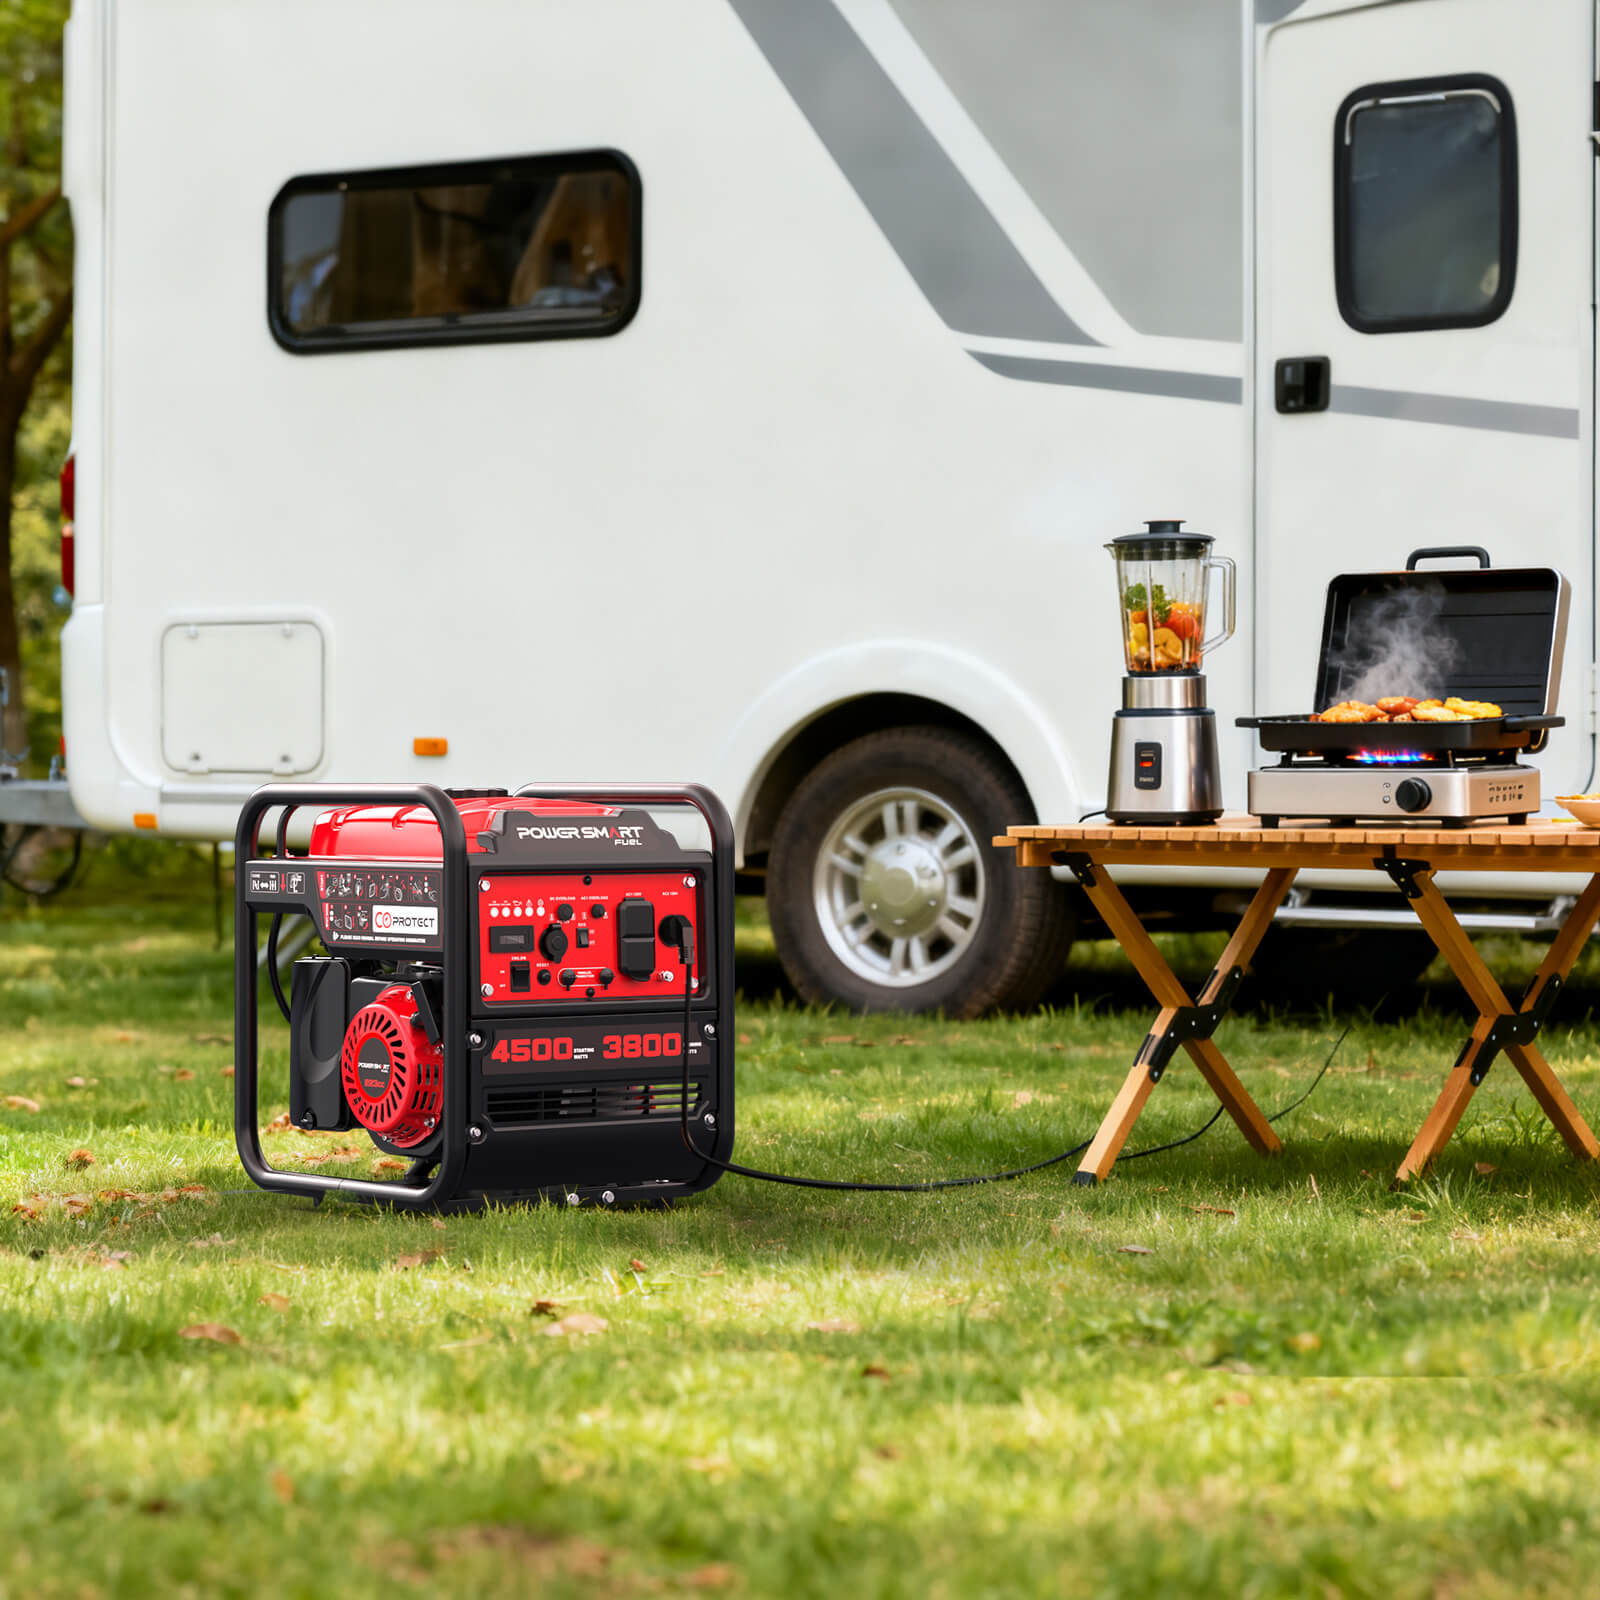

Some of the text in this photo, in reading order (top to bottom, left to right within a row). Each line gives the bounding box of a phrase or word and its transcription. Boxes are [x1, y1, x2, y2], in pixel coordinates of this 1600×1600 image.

[516, 826, 644, 839] POWER SMART
[614, 838, 643, 846] FUEL
[491, 1037, 573, 1063] 4500
[602, 1032, 682, 1060] 3800
